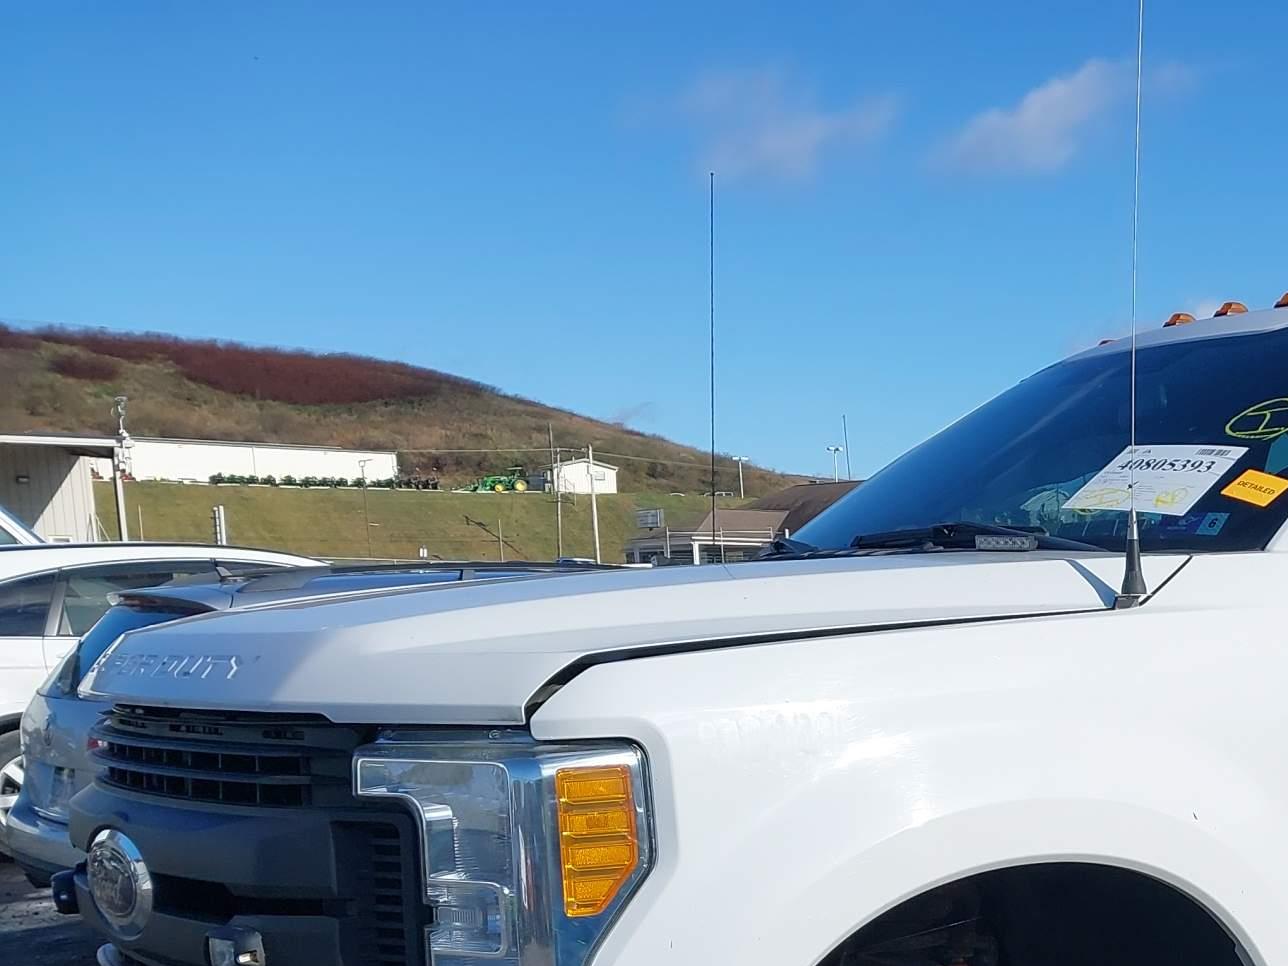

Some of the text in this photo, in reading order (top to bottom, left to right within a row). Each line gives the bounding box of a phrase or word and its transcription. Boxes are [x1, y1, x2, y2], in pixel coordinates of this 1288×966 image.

[1118, 458, 1216, 472] 40805393
[1237, 479, 1276, 496] DETAILED
[1207, 518, 1219, 529] 6
